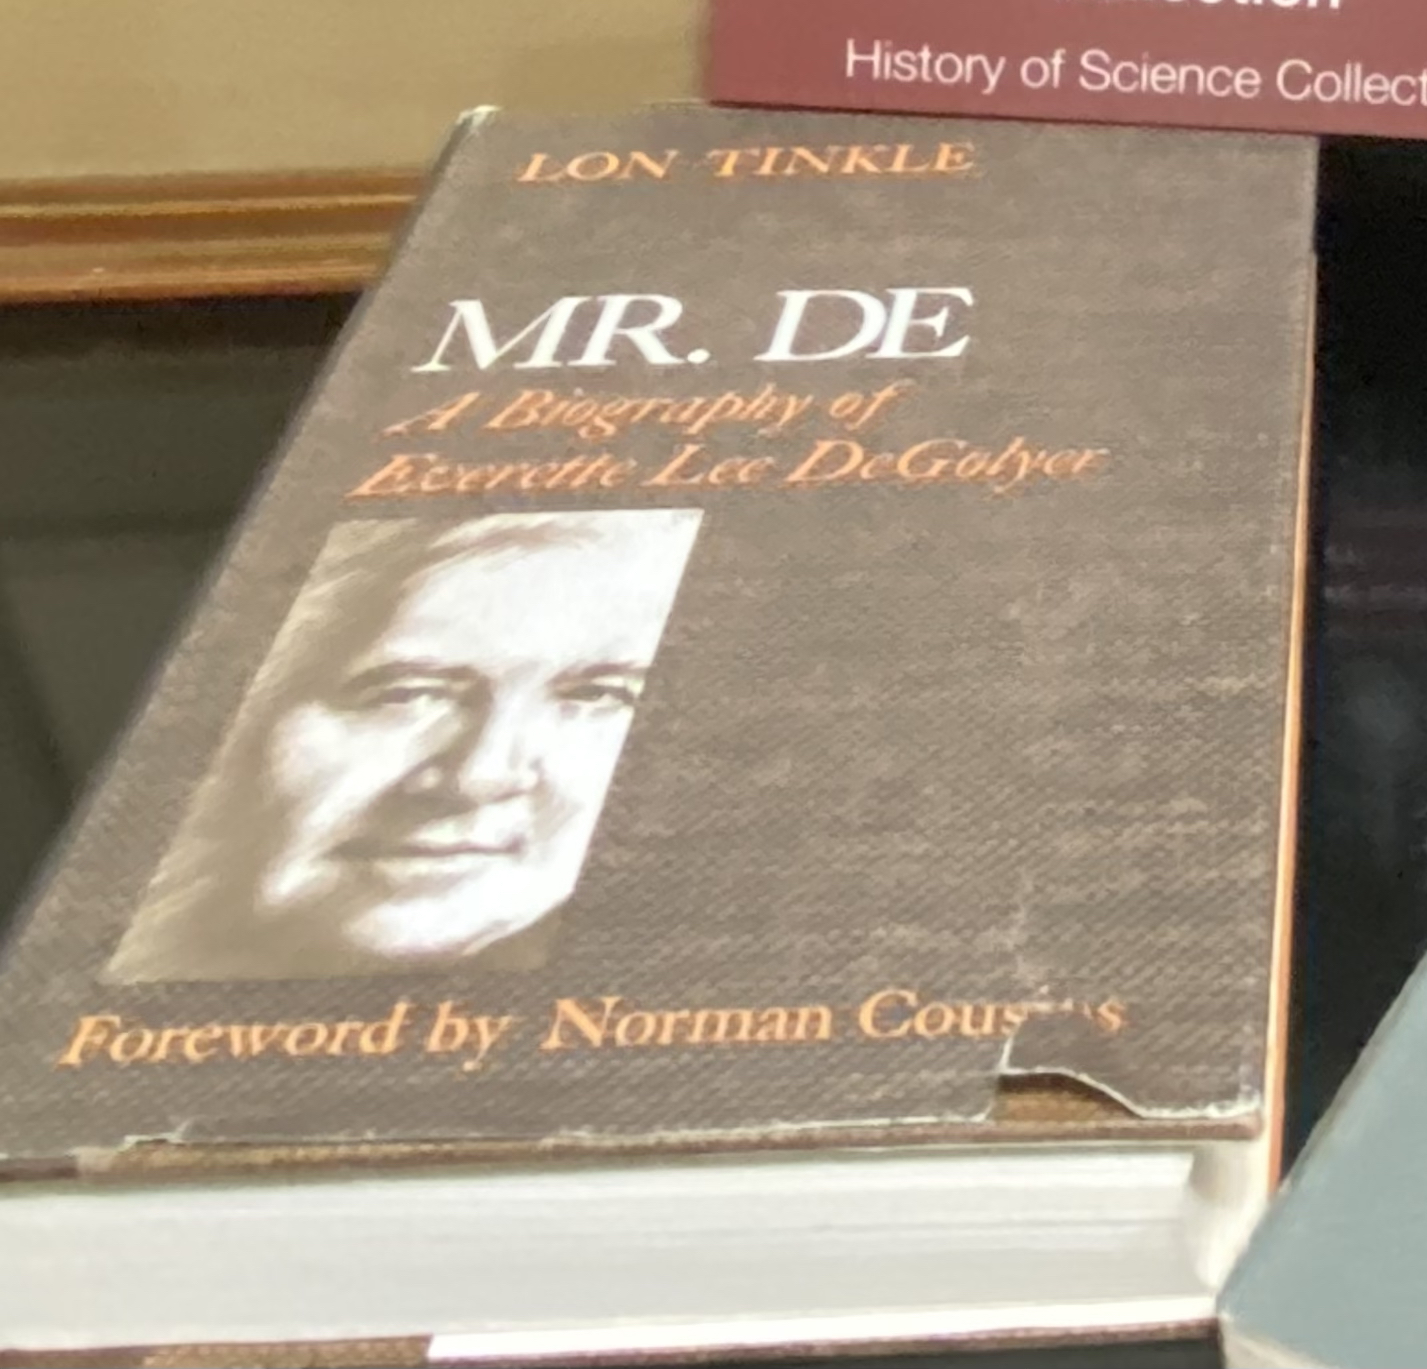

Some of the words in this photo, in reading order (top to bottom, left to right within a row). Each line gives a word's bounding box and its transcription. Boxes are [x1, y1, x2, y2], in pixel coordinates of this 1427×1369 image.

[844, 40, 1008, 95] History
[1020, 48, 1068, 89] of
[1079, 48, 1263, 101] Science
[516, 150, 680, 185] LON
[708, 141, 978, 182] TINKLE
[411, 293, 714, 375] MR.
[753, 286, 975, 362] DE
[382, 391, 482, 436] A
[487, 386, 813, 441] Biography
[829, 378, 913, 423] of
[345, 450, 638, 502] Everette
[643, 443, 775, 488] Lee
[786, 436, 1111, 501] DeGolyer
[54, 999, 410, 1071] Foreword
[426, 1002, 514, 1080] by
[539, 996, 834, 1052] Norman
[857, 987, 1128, 1039] Couss
